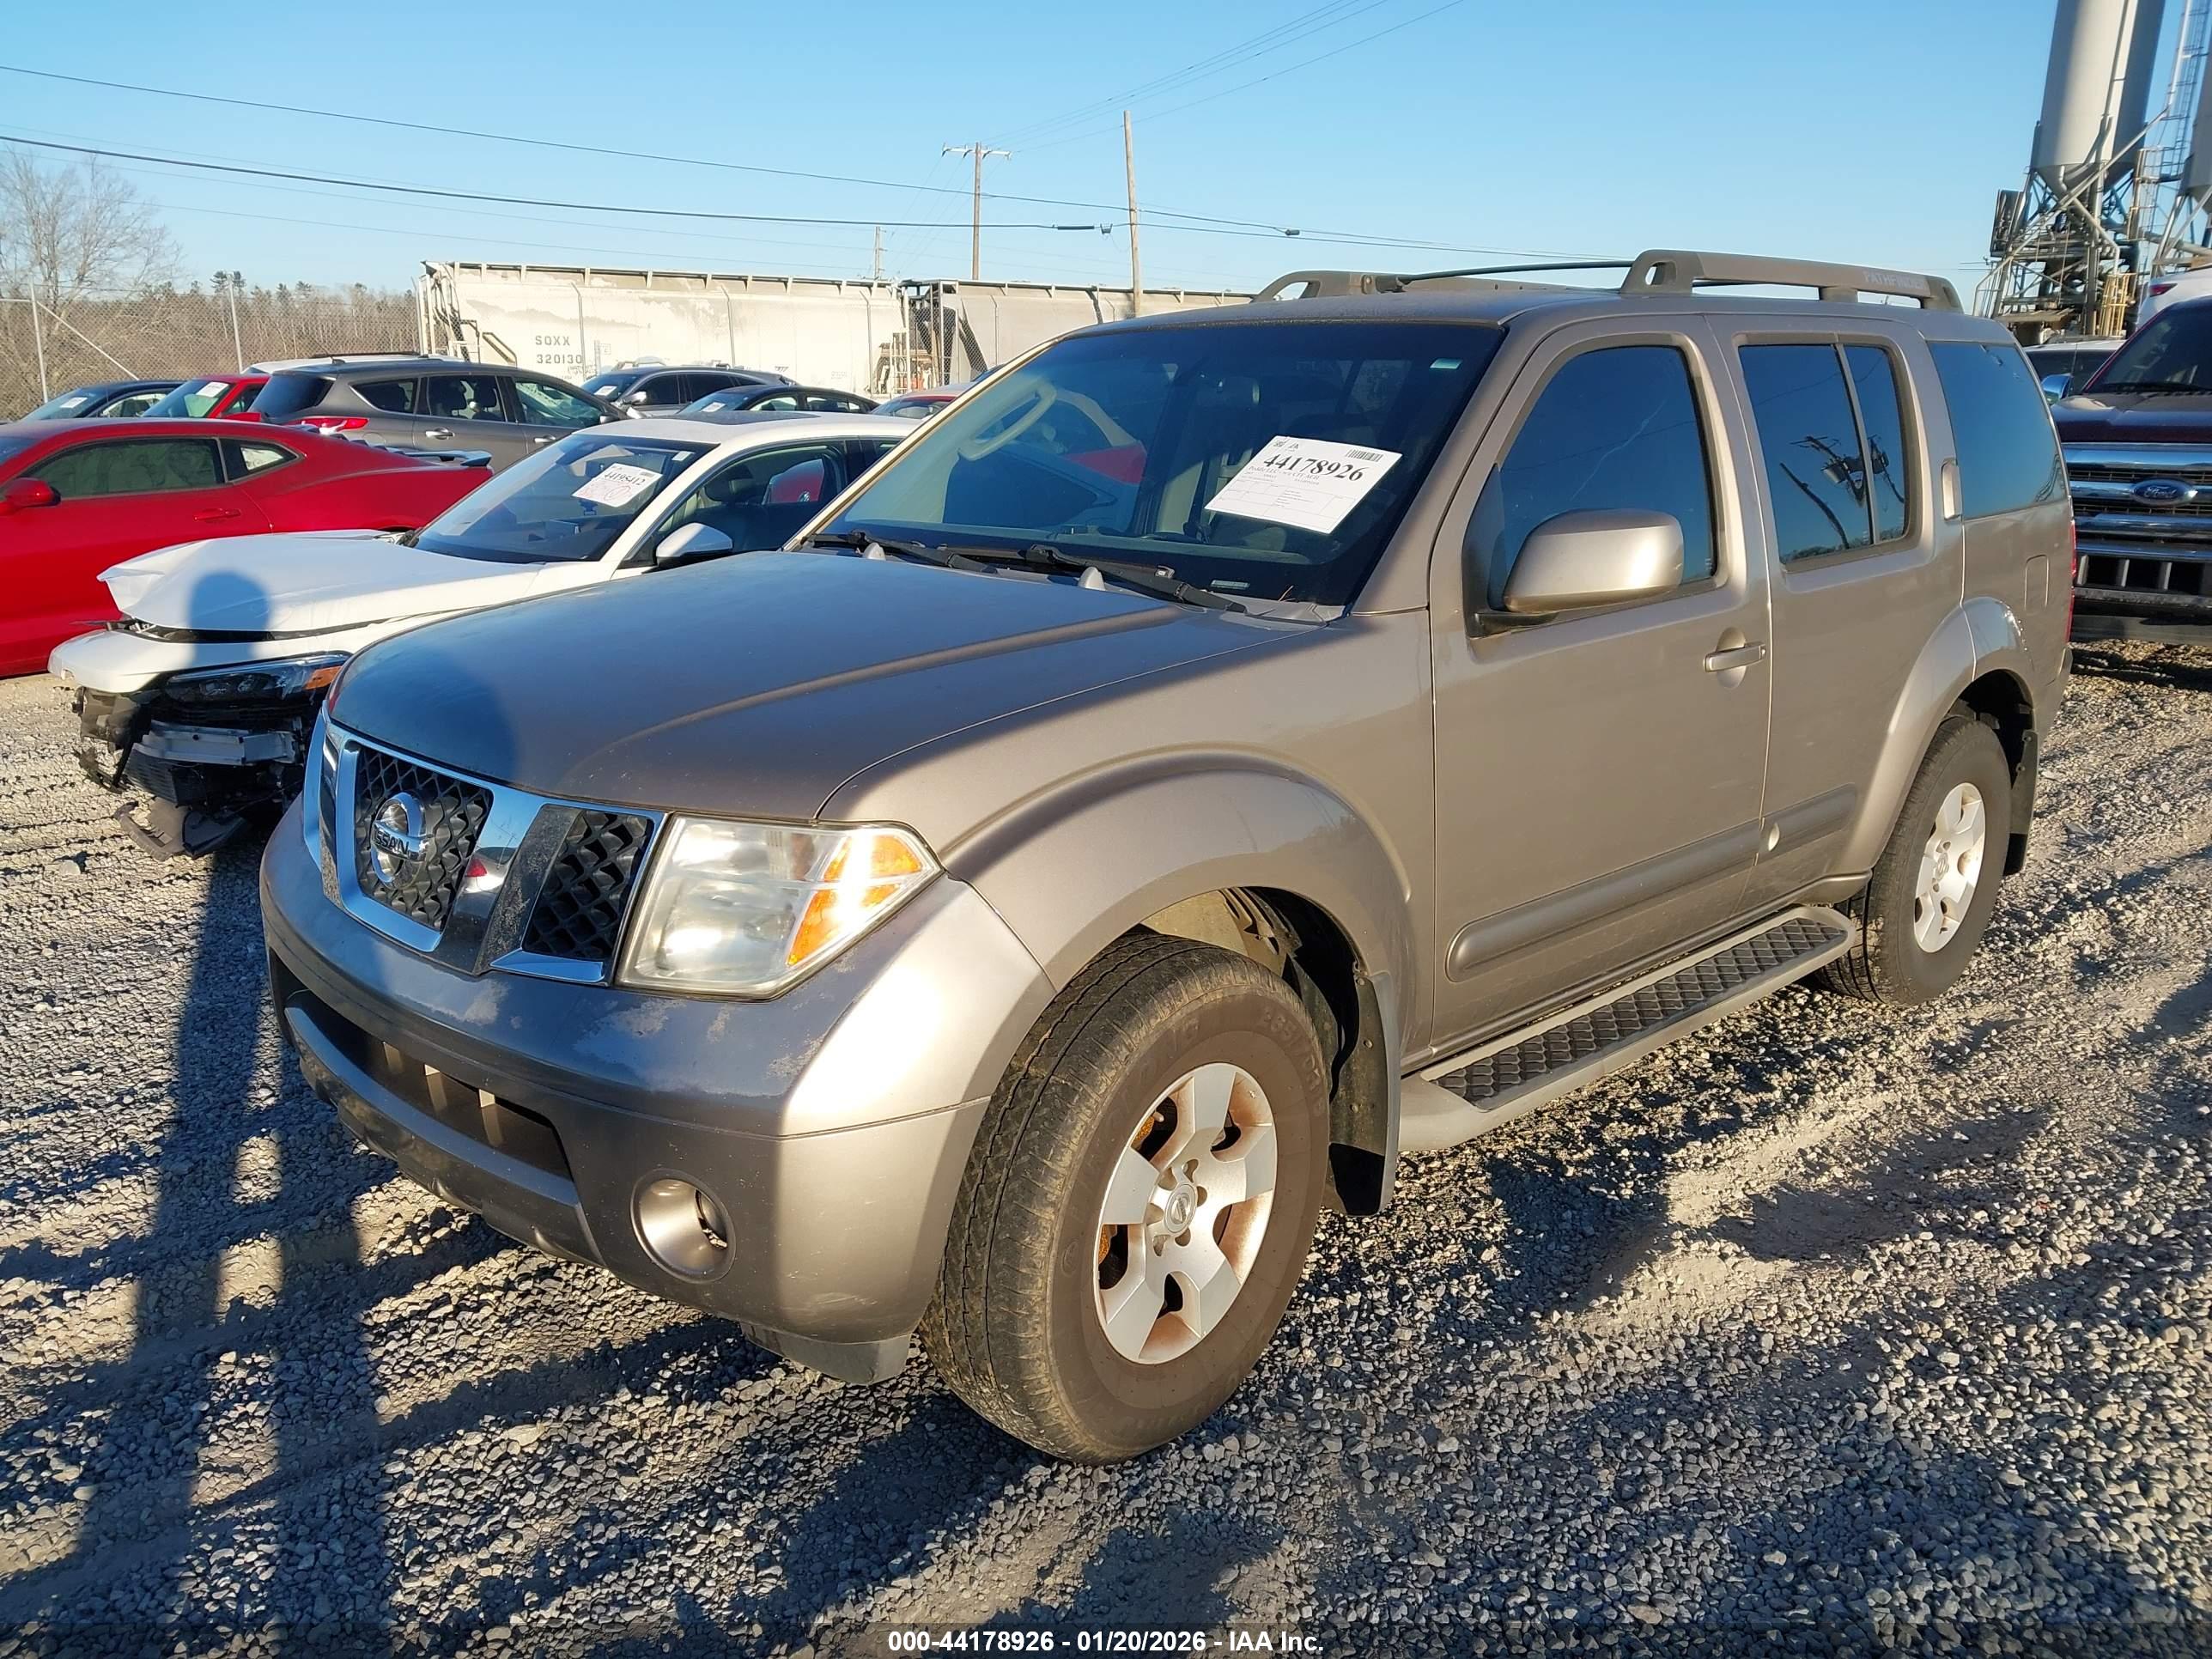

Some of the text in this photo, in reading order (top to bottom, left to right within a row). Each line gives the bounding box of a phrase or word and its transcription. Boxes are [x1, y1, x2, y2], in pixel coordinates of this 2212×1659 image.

[535, 335, 570, 346] SOXX
[537, 354, 582, 364] 320130
[1263, 453, 1369, 482] 44178926
[2143, 485, 2178, 499] Ford
